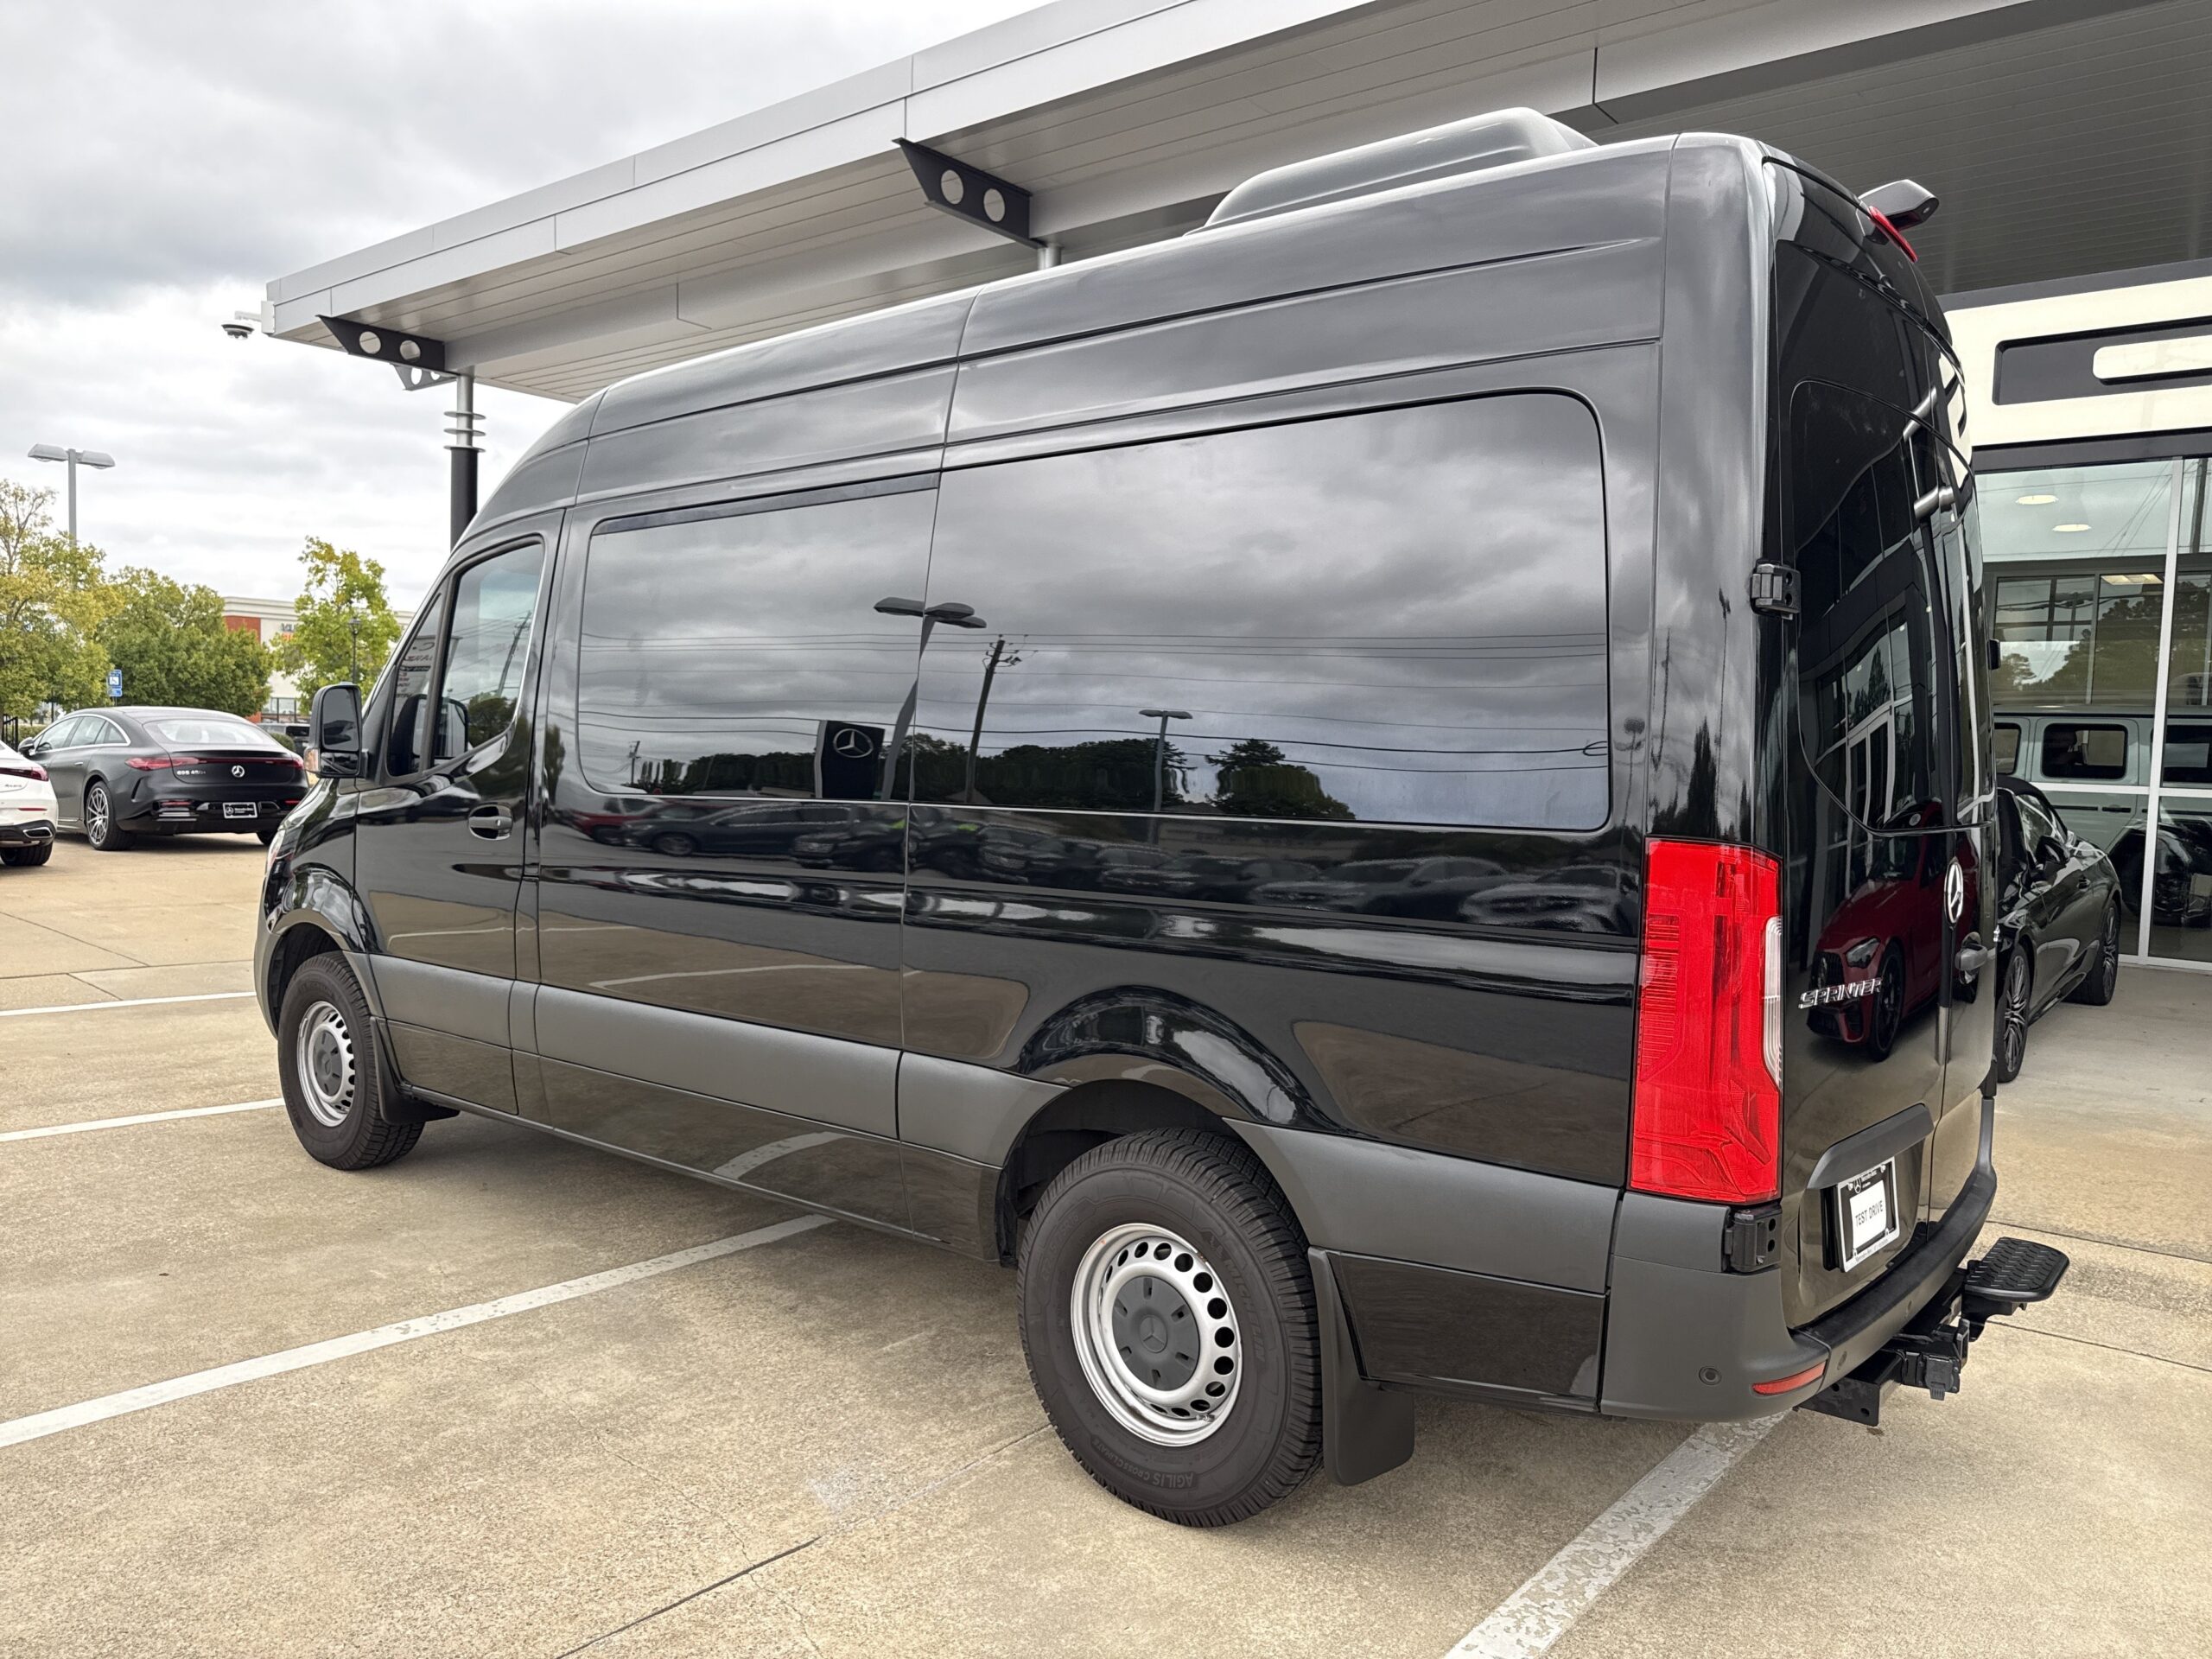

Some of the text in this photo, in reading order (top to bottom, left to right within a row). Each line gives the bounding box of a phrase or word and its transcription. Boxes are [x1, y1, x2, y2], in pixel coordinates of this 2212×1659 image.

[1798, 977, 1883, 1009] SPRINTER
[1854, 1200, 1884, 1226] TEST DRIVE
[1152, 1471, 1194, 1489] AGILIS
